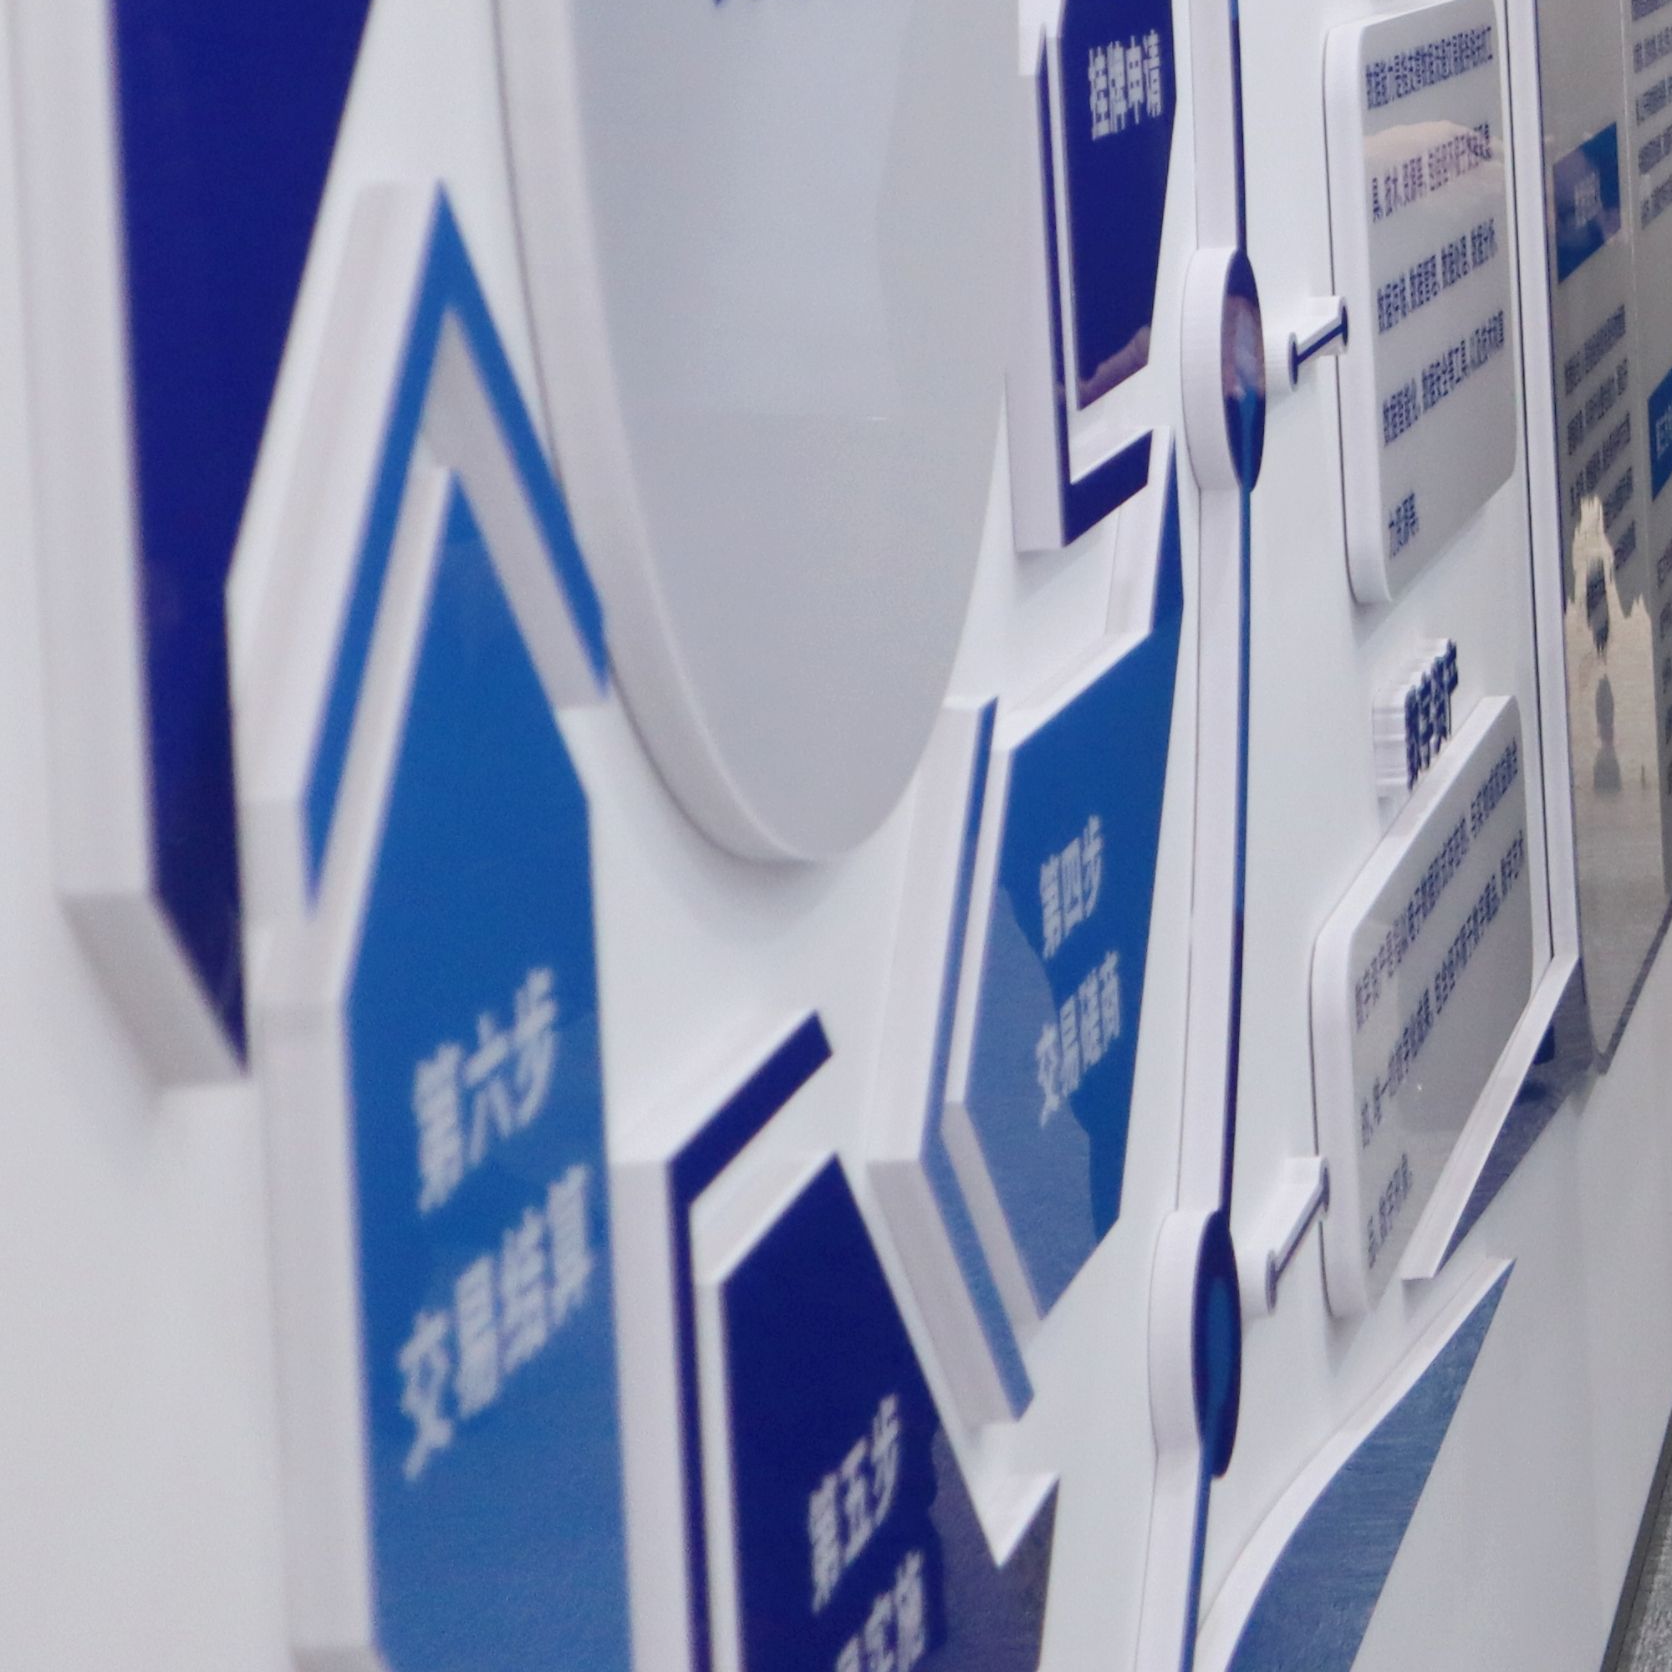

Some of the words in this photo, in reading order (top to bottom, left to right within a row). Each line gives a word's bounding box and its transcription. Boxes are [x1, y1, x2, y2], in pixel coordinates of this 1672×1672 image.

[1088, 28, 1161, 141] 挂牌申请
[1040, 814, 1103, 961] 第四步
[414, 966, 560, 1215] 第六步
[808, 1393, 899, 1616] 第五步
